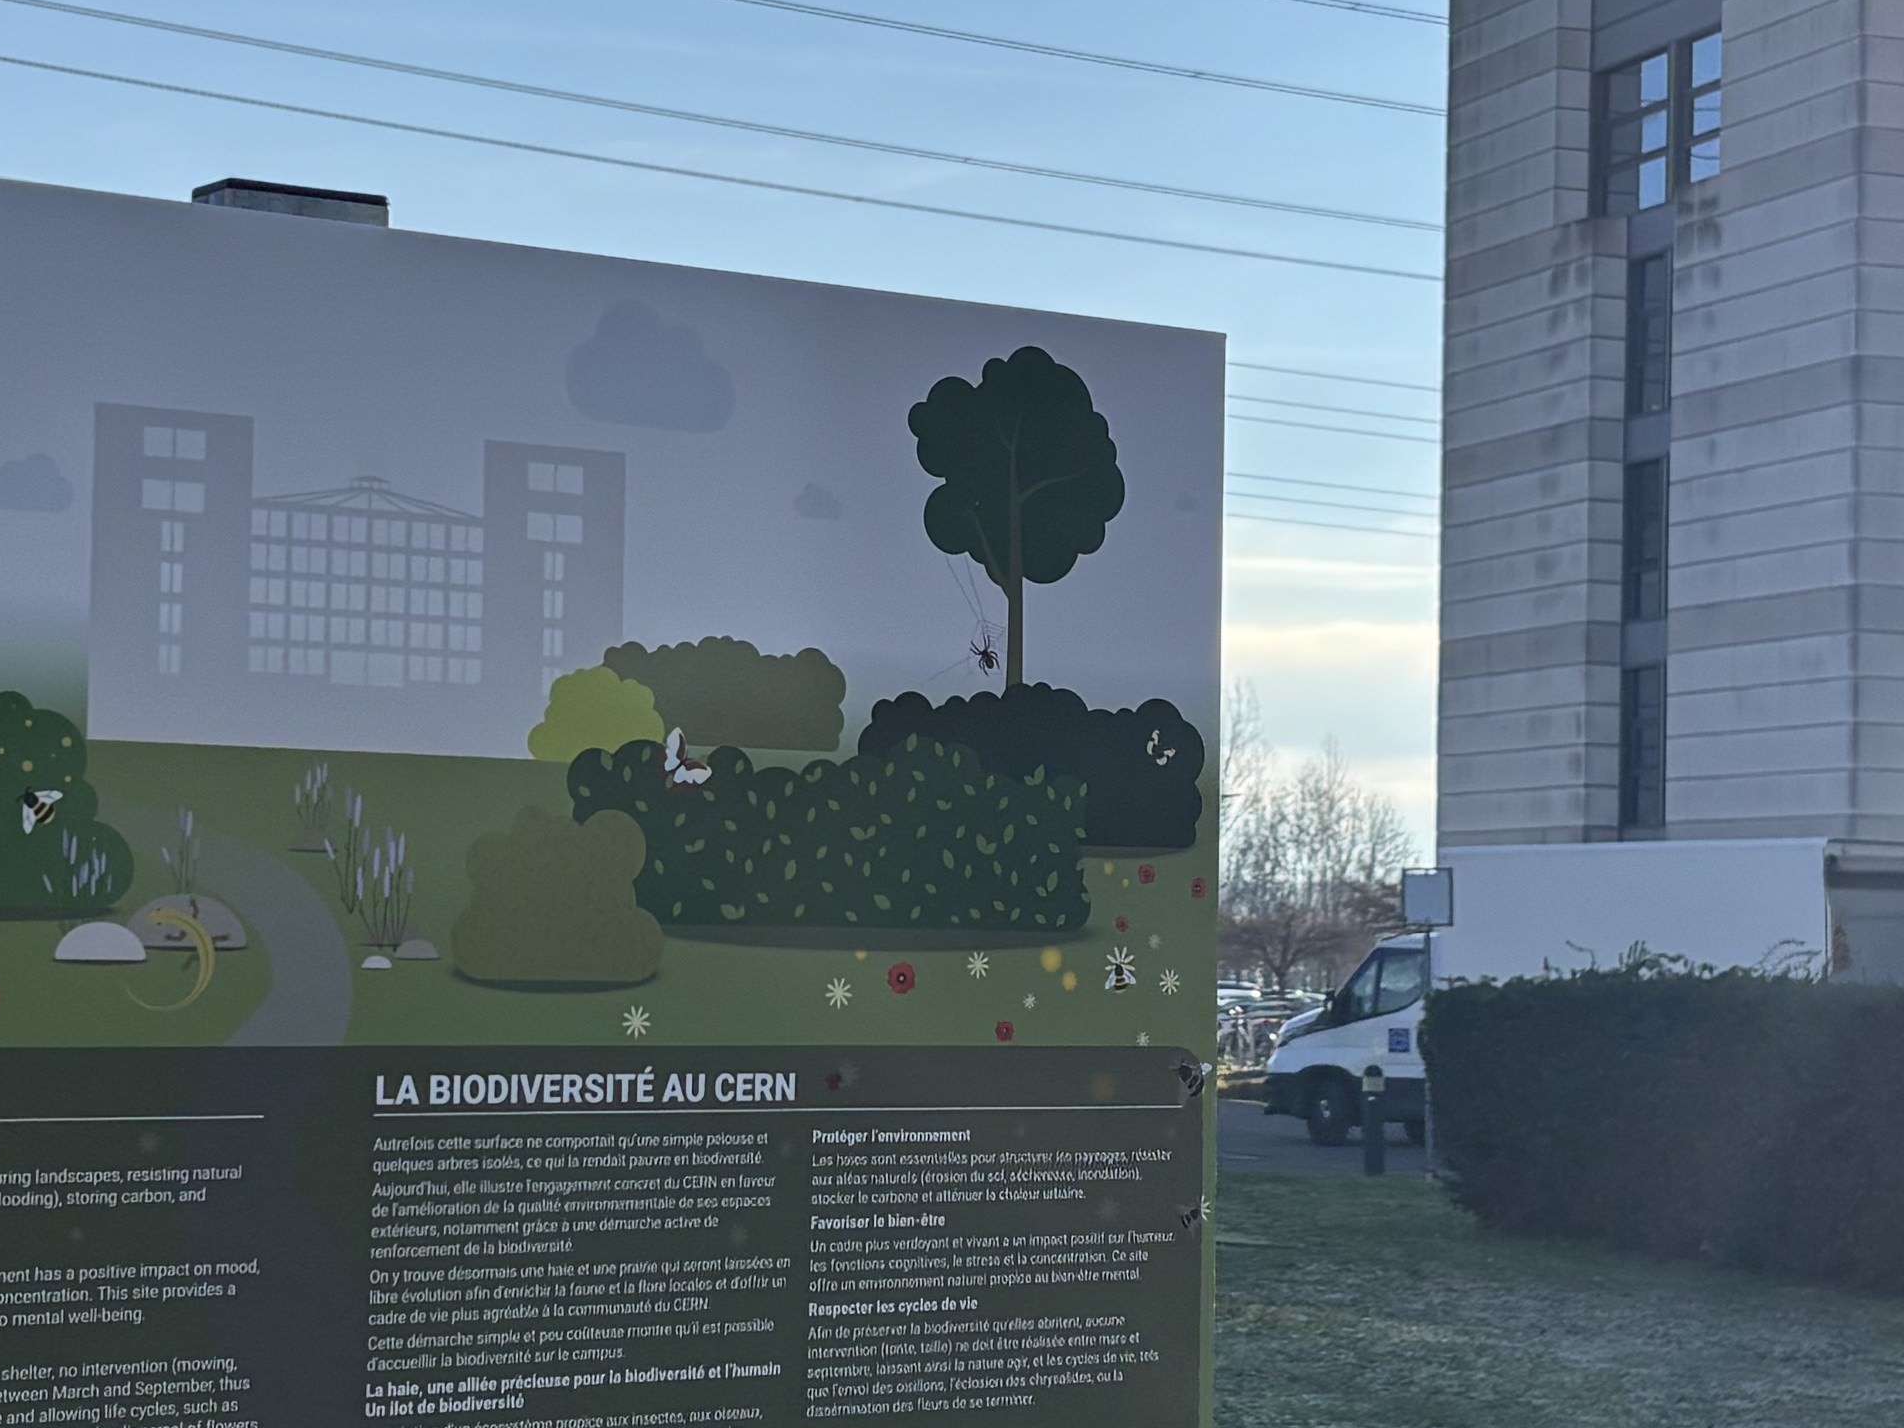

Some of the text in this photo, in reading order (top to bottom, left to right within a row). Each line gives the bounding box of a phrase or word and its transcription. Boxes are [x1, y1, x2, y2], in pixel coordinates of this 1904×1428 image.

[376, 1066, 796, 1105] LA BIODIVERSITÉ AU CERN
[813, 1130, 868, 1146] Protéger
[35, 1168, 123, 1186] landscapes,
[127, 1168, 189, 1184] resisting
[193, 1165, 242, 1180] natural
[811, 1213, 945, 1230] Favoriser le bien-être
[809, 1296, 978, 1319] Respecter les cycles de vie
